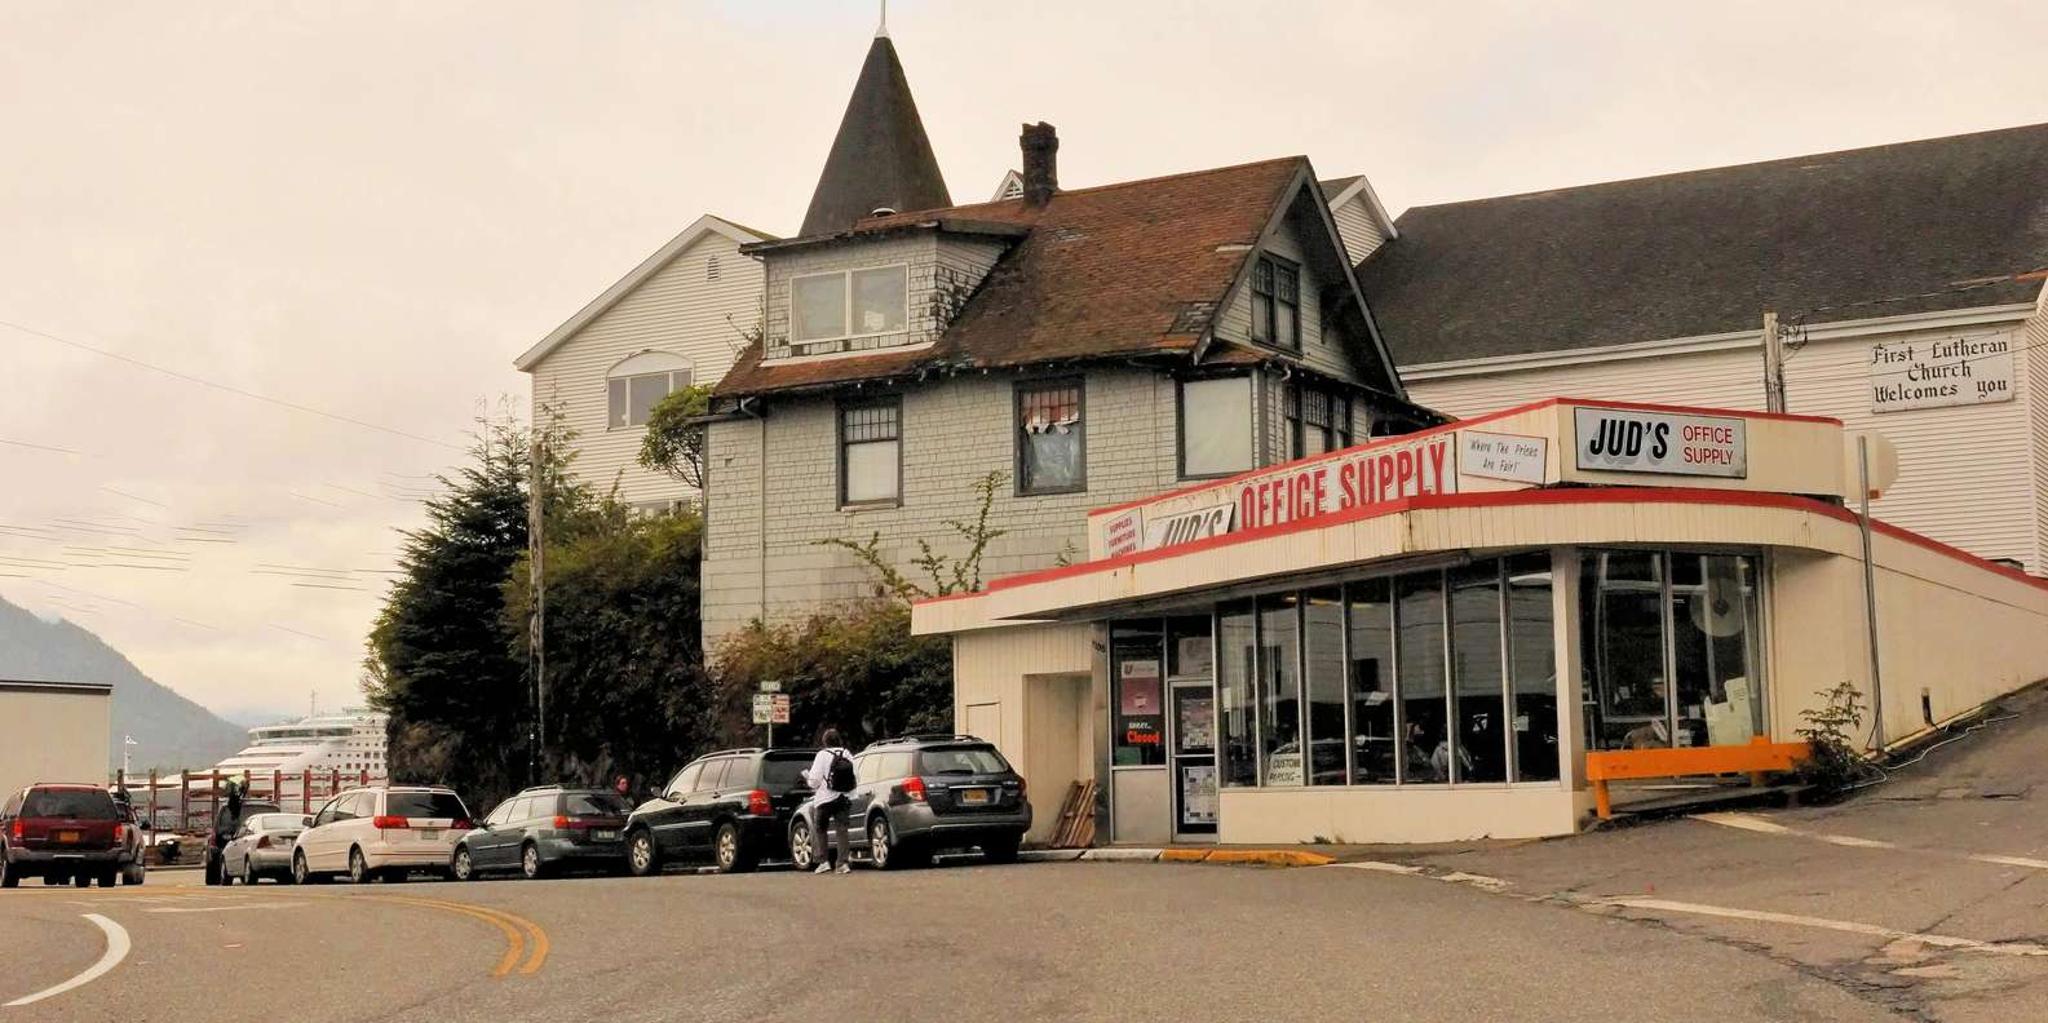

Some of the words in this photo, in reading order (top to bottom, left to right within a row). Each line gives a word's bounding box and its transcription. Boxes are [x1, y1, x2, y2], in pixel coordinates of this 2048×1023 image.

[1871, 343, 1913, 365] First
[1932, 339, 2008, 359] Lutheran
[1907, 360, 1971, 381] Church
[1874, 383, 1958, 403] Welcomes
[1977, 379, 2007, 399] you
[1590, 418, 1669, 460] JUD'S
[1683, 425, 1733, 444] OFFICE
[1684, 447, 1734, 465] SUPPLY
[1241, 469, 1328, 531] OFFICE
[1340, 441, 1446, 508] SUPPLY
